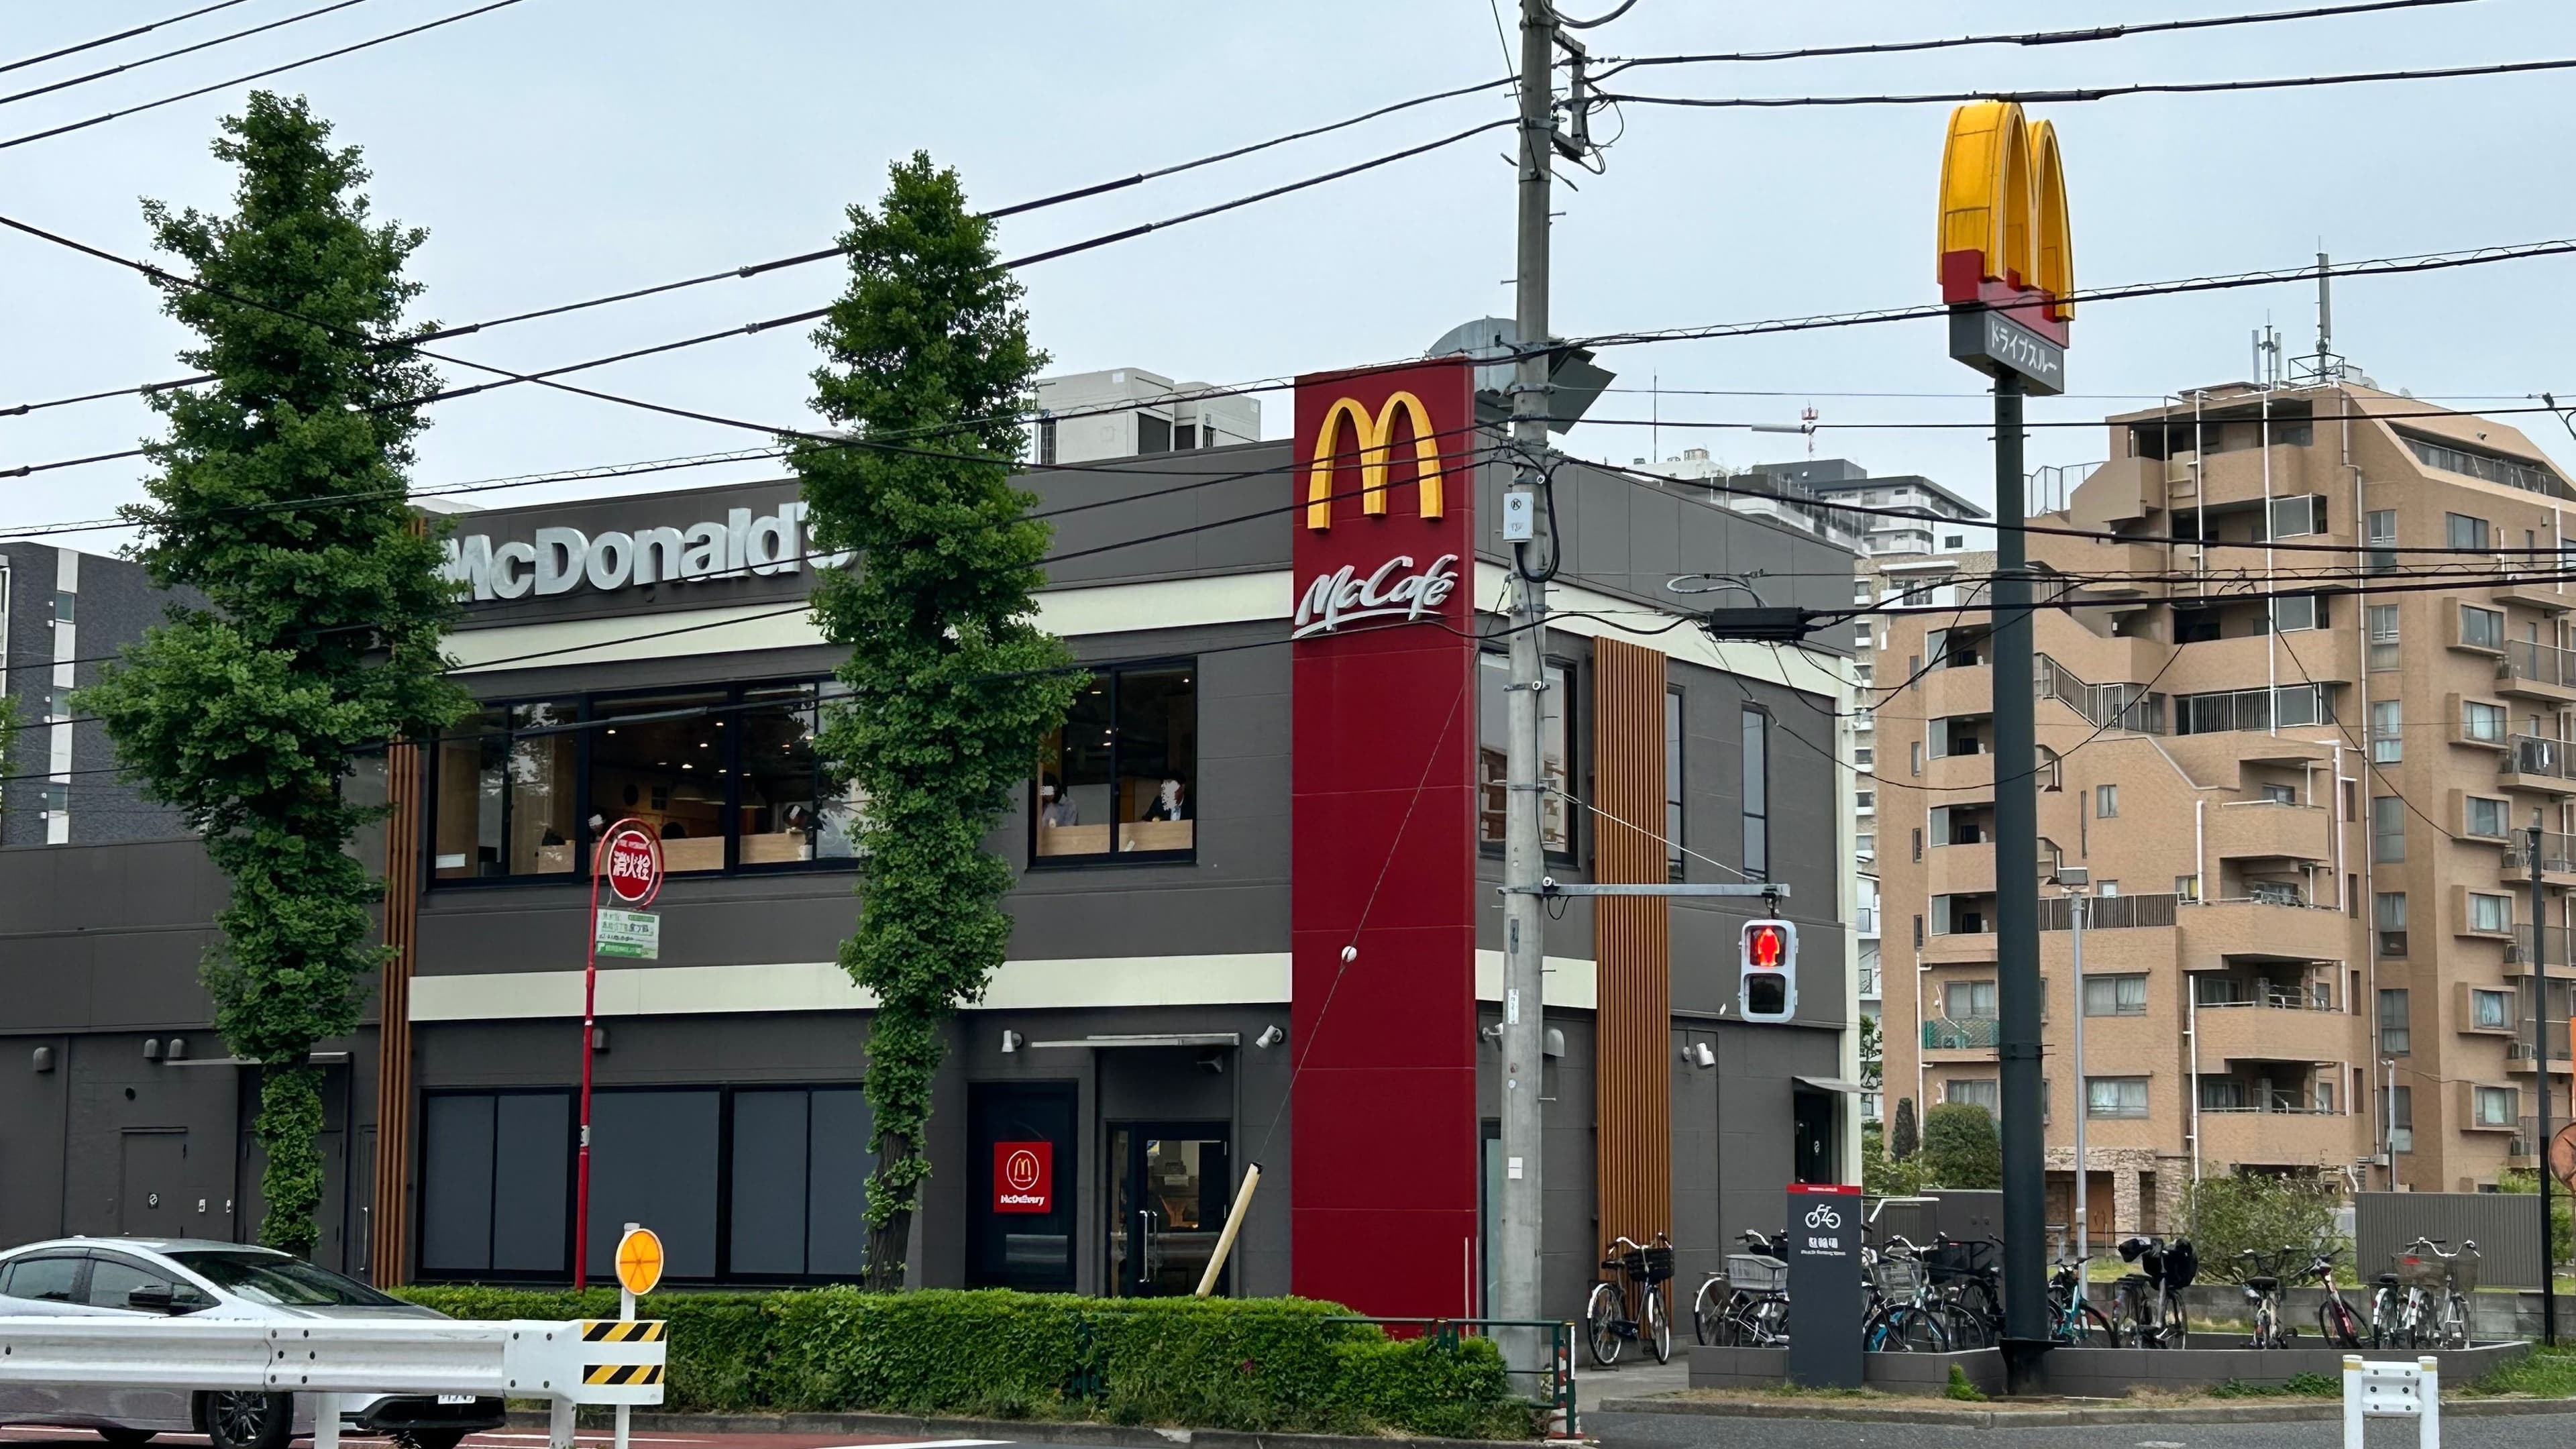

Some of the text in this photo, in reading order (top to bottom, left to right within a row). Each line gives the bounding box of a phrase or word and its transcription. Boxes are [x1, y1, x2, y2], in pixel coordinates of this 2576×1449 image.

[1991, 320, 2057, 373] ドライブスルー
[1293, 554, 1458, 632] McCafé
[612, 851, 651, 881] 消火栓
